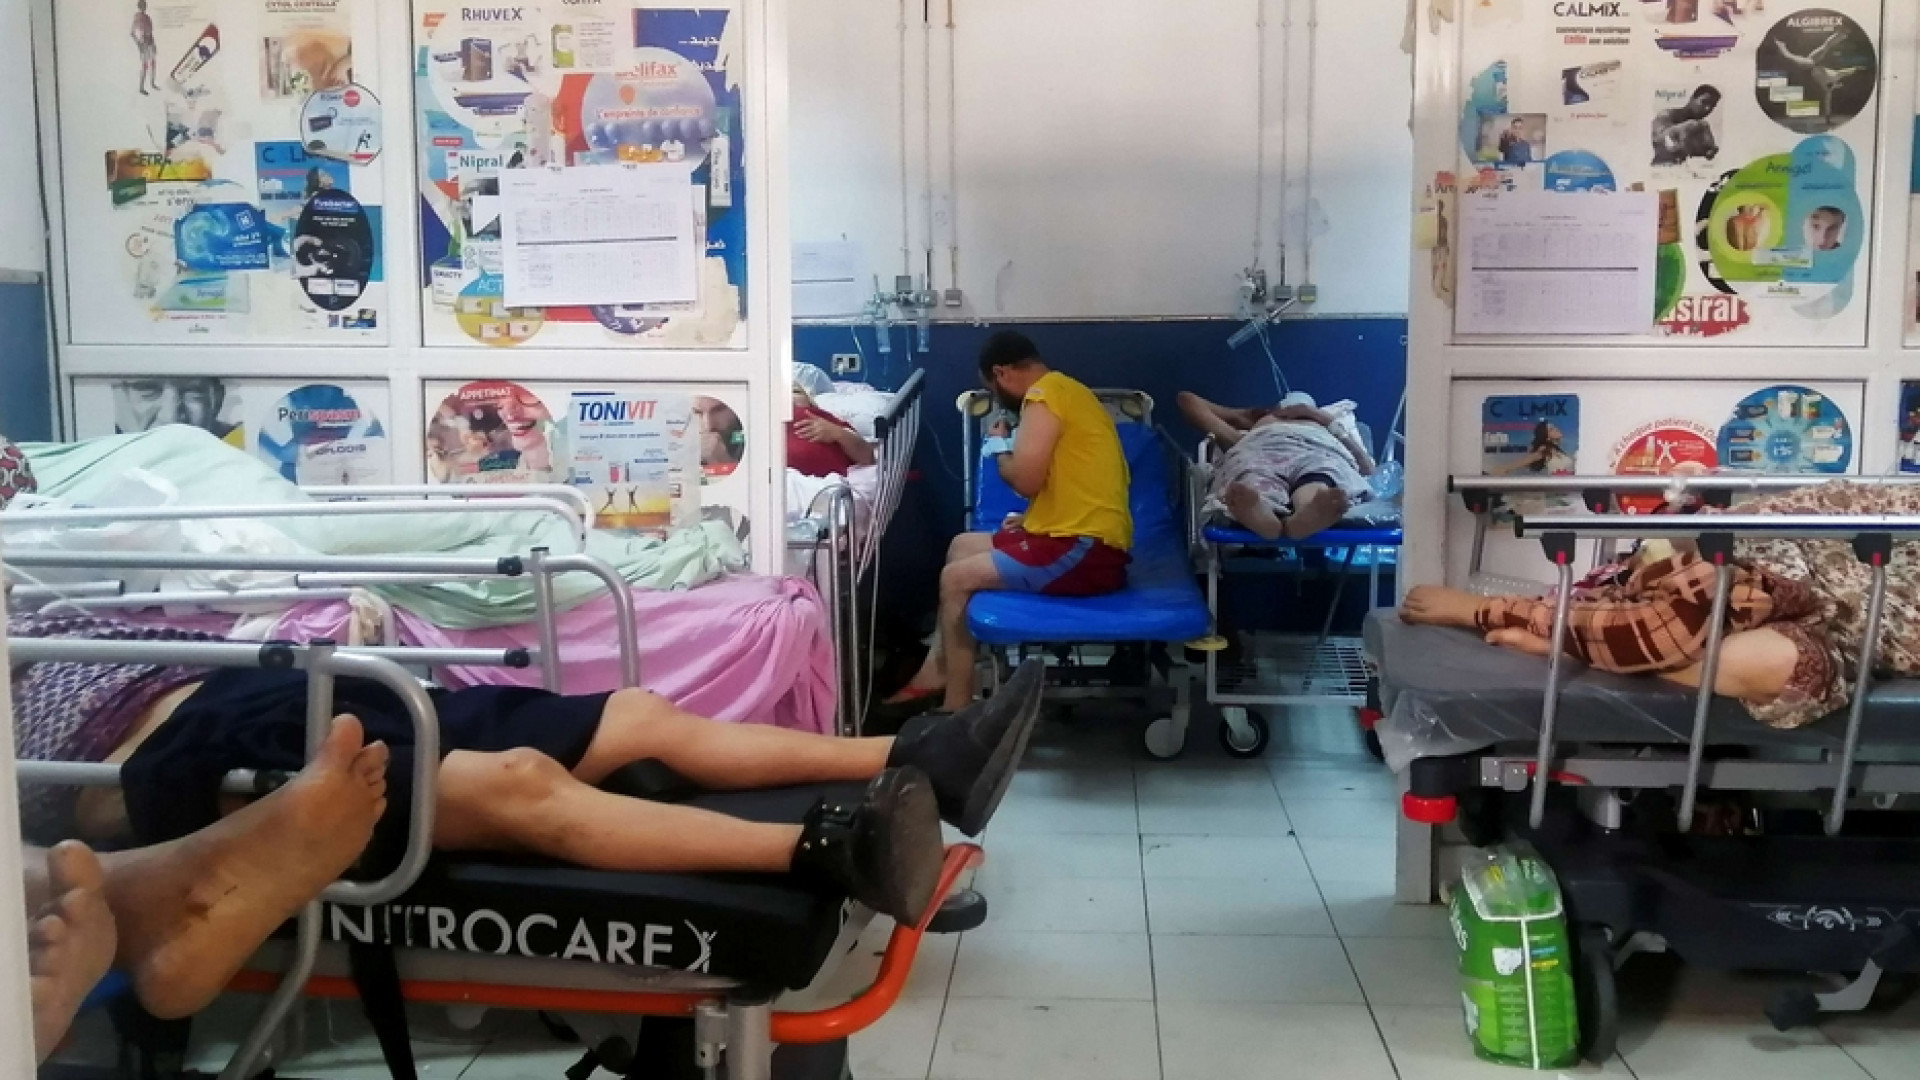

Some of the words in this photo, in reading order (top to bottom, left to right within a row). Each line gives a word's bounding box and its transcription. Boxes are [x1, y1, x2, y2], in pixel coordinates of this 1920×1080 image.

[462, 8, 523, 21] RHUVEX
[1554, 2, 1620, 17] CALMIX
[460, 154, 504, 172] Nipral
[579, 401, 659, 421] TONIVIT
[330, 903, 674, 968] NITROCARE
